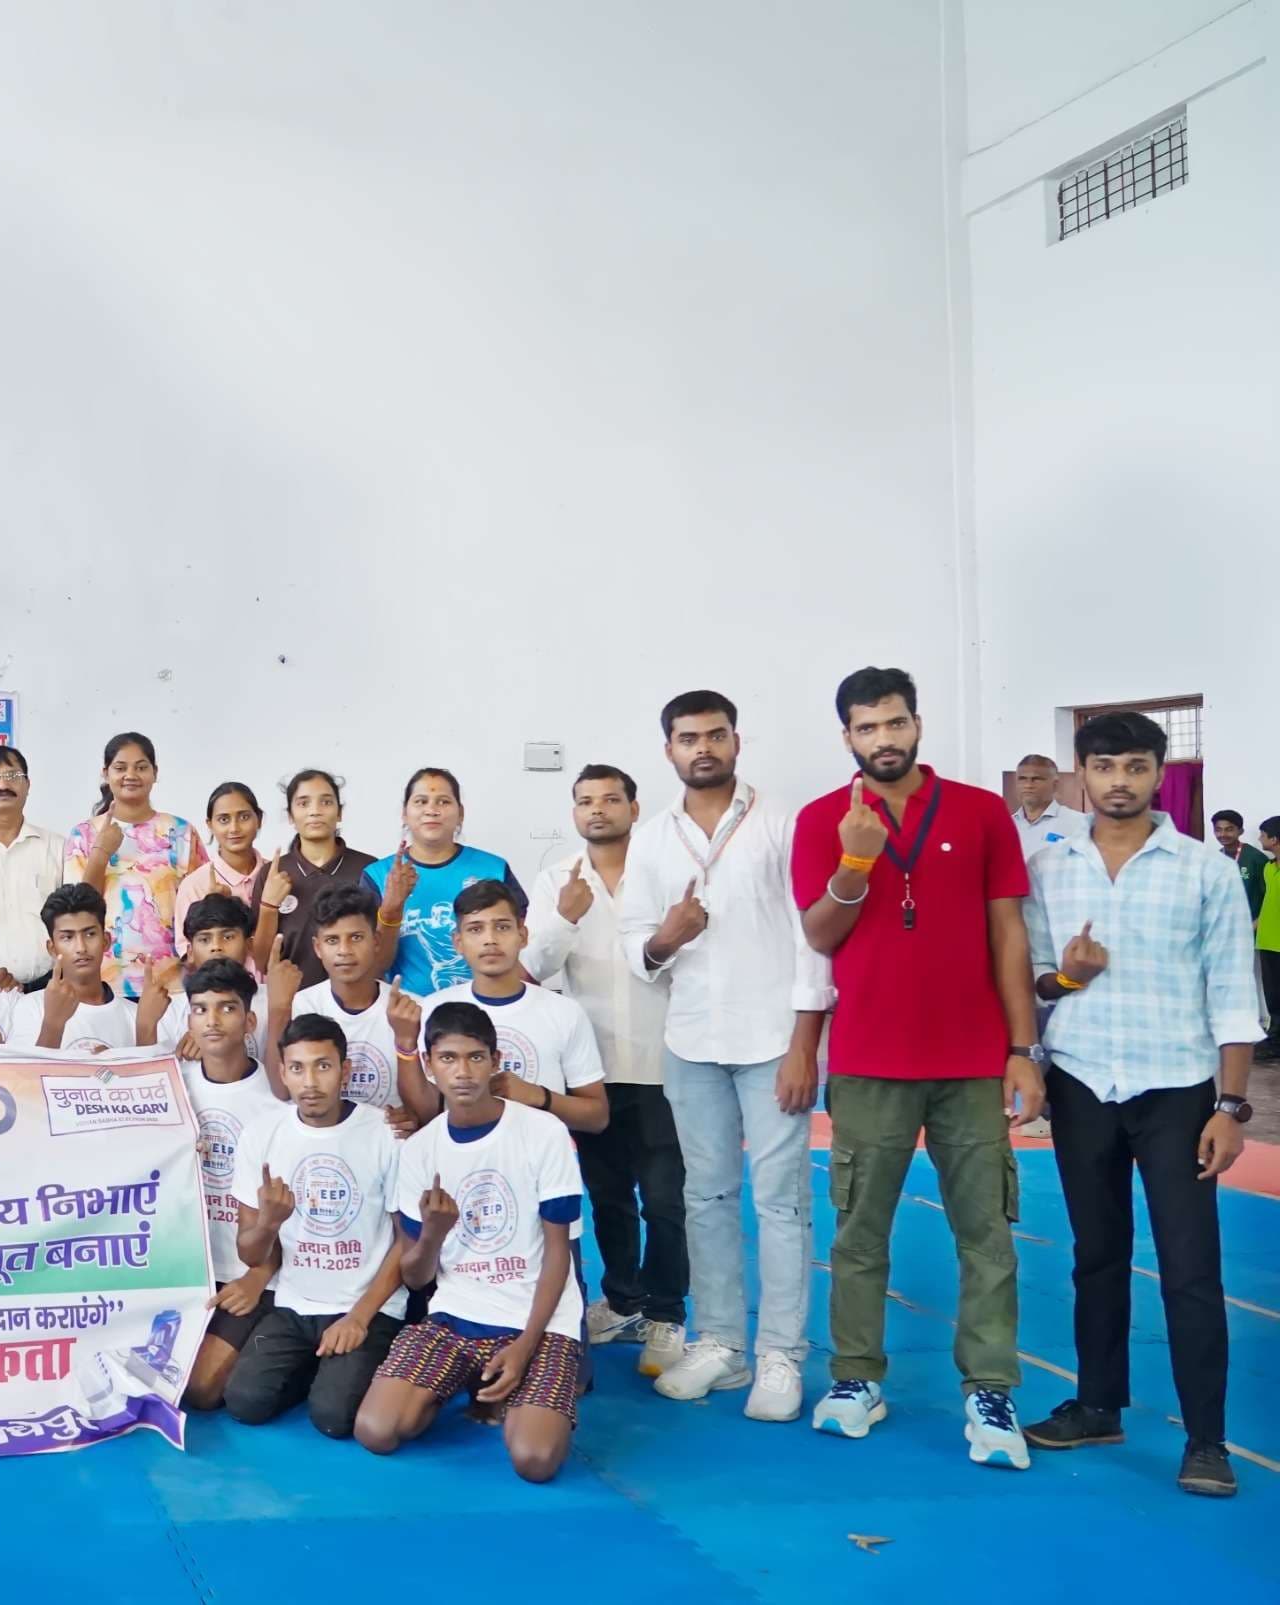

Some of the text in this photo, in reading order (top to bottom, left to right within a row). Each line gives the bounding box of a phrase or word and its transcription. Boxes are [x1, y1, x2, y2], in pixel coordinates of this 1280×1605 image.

[351, 1073, 376, 1083] EEP
[50, 1077, 168, 1109] चुनाव का पर्व
[75, 1102, 169, 1116] DESH KA GARV
[212, 1142, 235, 1156] EEP
[36, 1169, 160, 1222] निभाएं
[45, 1220, 150, 1268] बनाएं
[297, 1239, 362, 1255] तदान तिथि
[293, 1256, 360, 1271] 6.11.2025
[495, 1256, 527, 1271] तिथि
